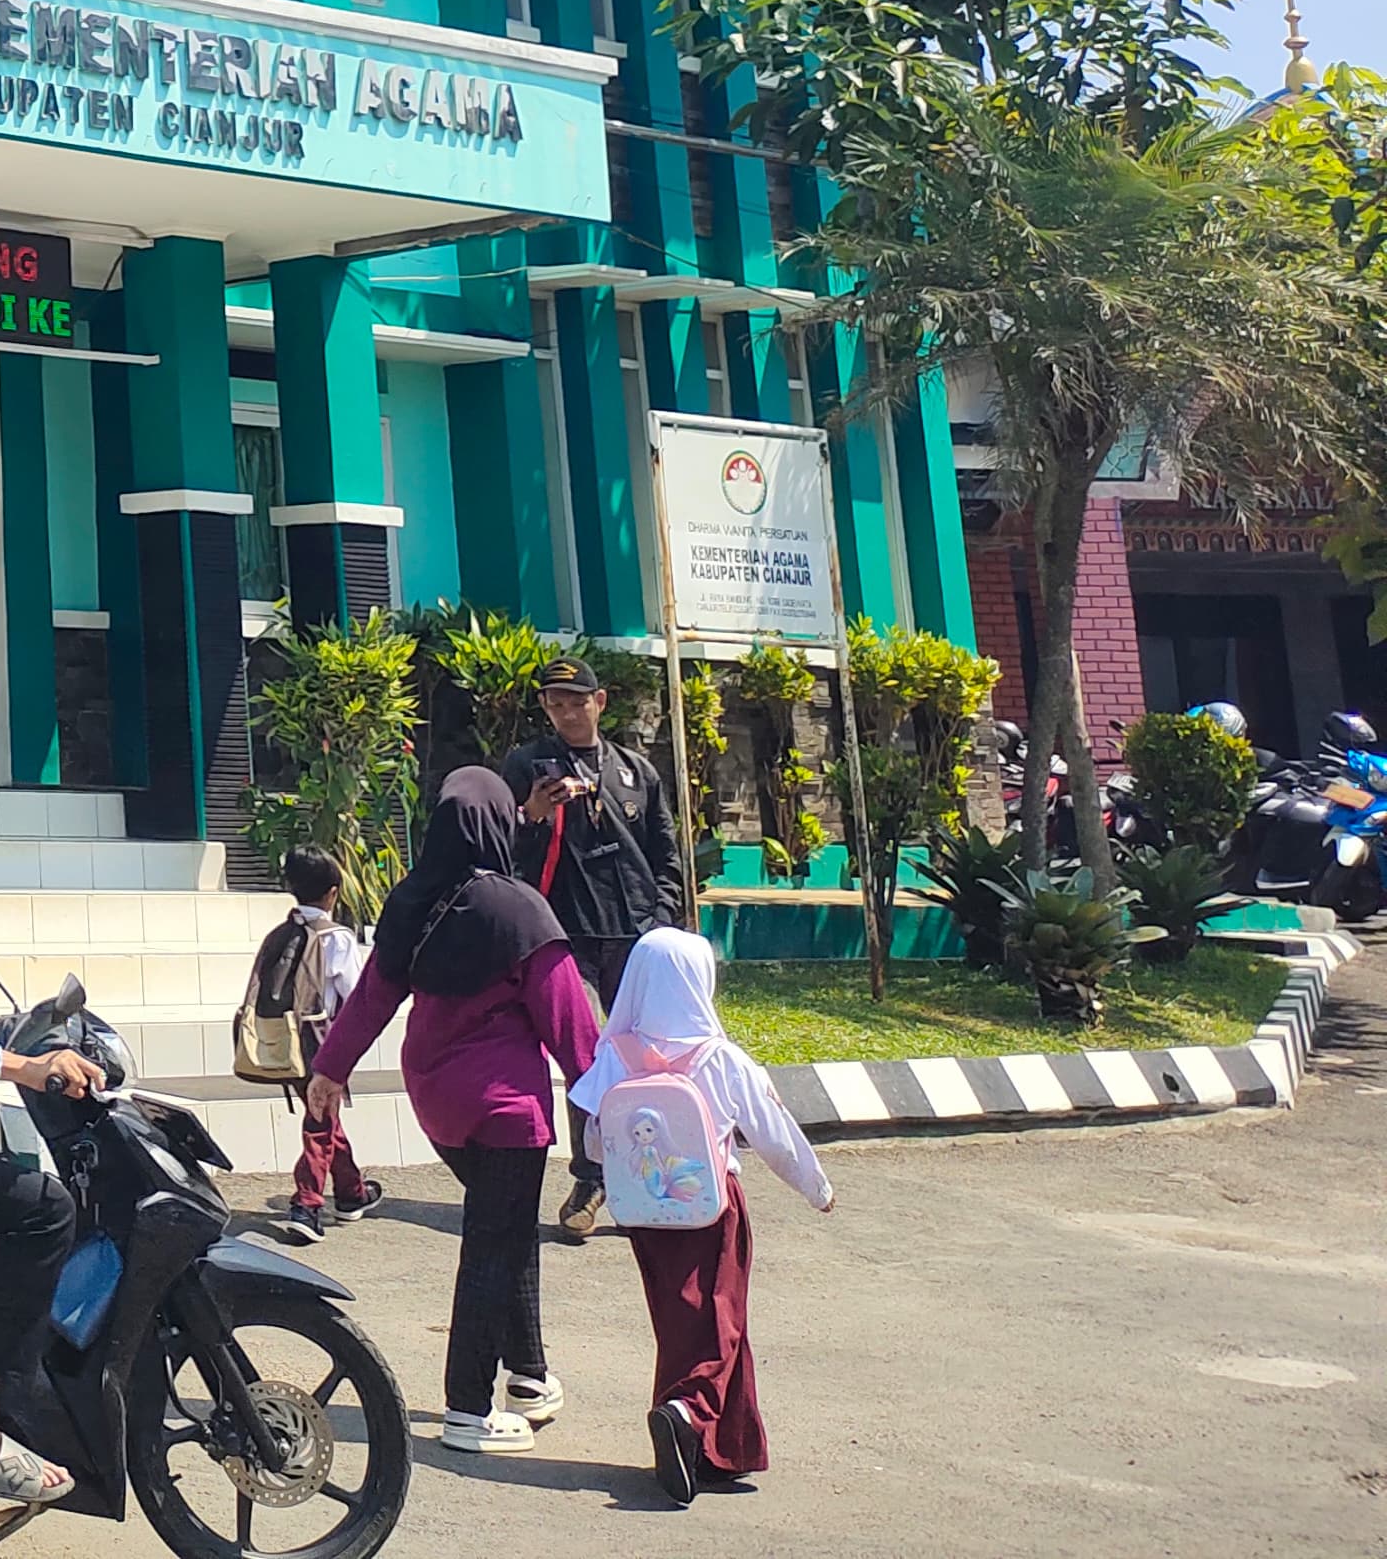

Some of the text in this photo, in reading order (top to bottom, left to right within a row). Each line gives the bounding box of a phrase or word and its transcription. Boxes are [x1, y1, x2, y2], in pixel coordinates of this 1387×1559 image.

[353, 56, 524, 143] AGAMA
[158, 101, 306, 159] CIANJUR
[28, 297, 73, 338] KE
[690, 545, 810, 569] KEMENTERIAN AGAMA
[690, 563, 813, 587] KABUPATEN CIANJUR
